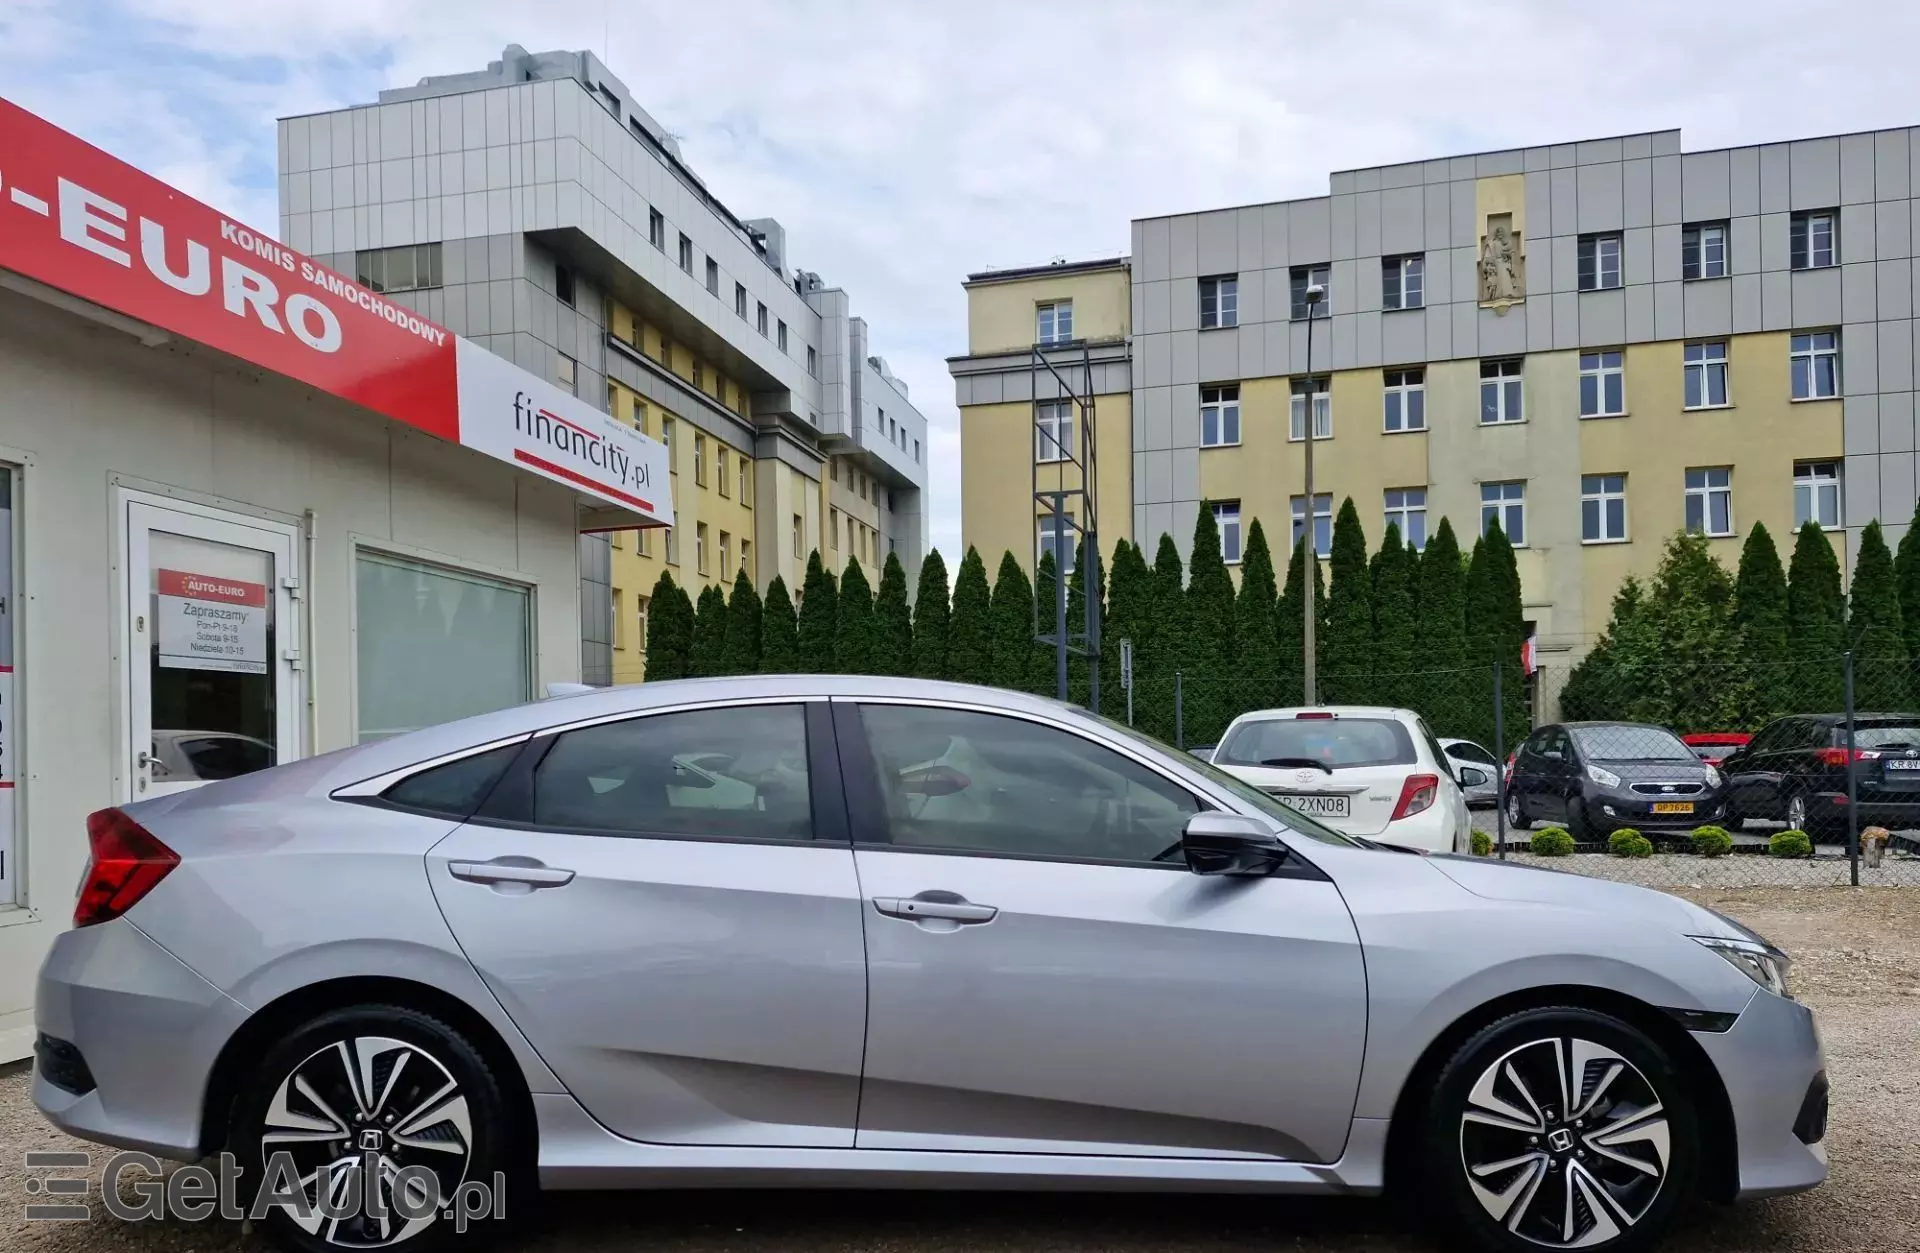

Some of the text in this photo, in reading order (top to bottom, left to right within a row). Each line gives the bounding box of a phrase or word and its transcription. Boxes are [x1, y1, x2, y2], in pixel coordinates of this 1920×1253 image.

[0, 169, 342, 353] -EURO
[219, 219, 447, 348] KOMIS SAMOCHODOWY
[512, 391, 651, 490] financity.pl
[187, 580, 246, 598] AUTO-EURO
[1297, 797, 1345, 813] 2XN08
